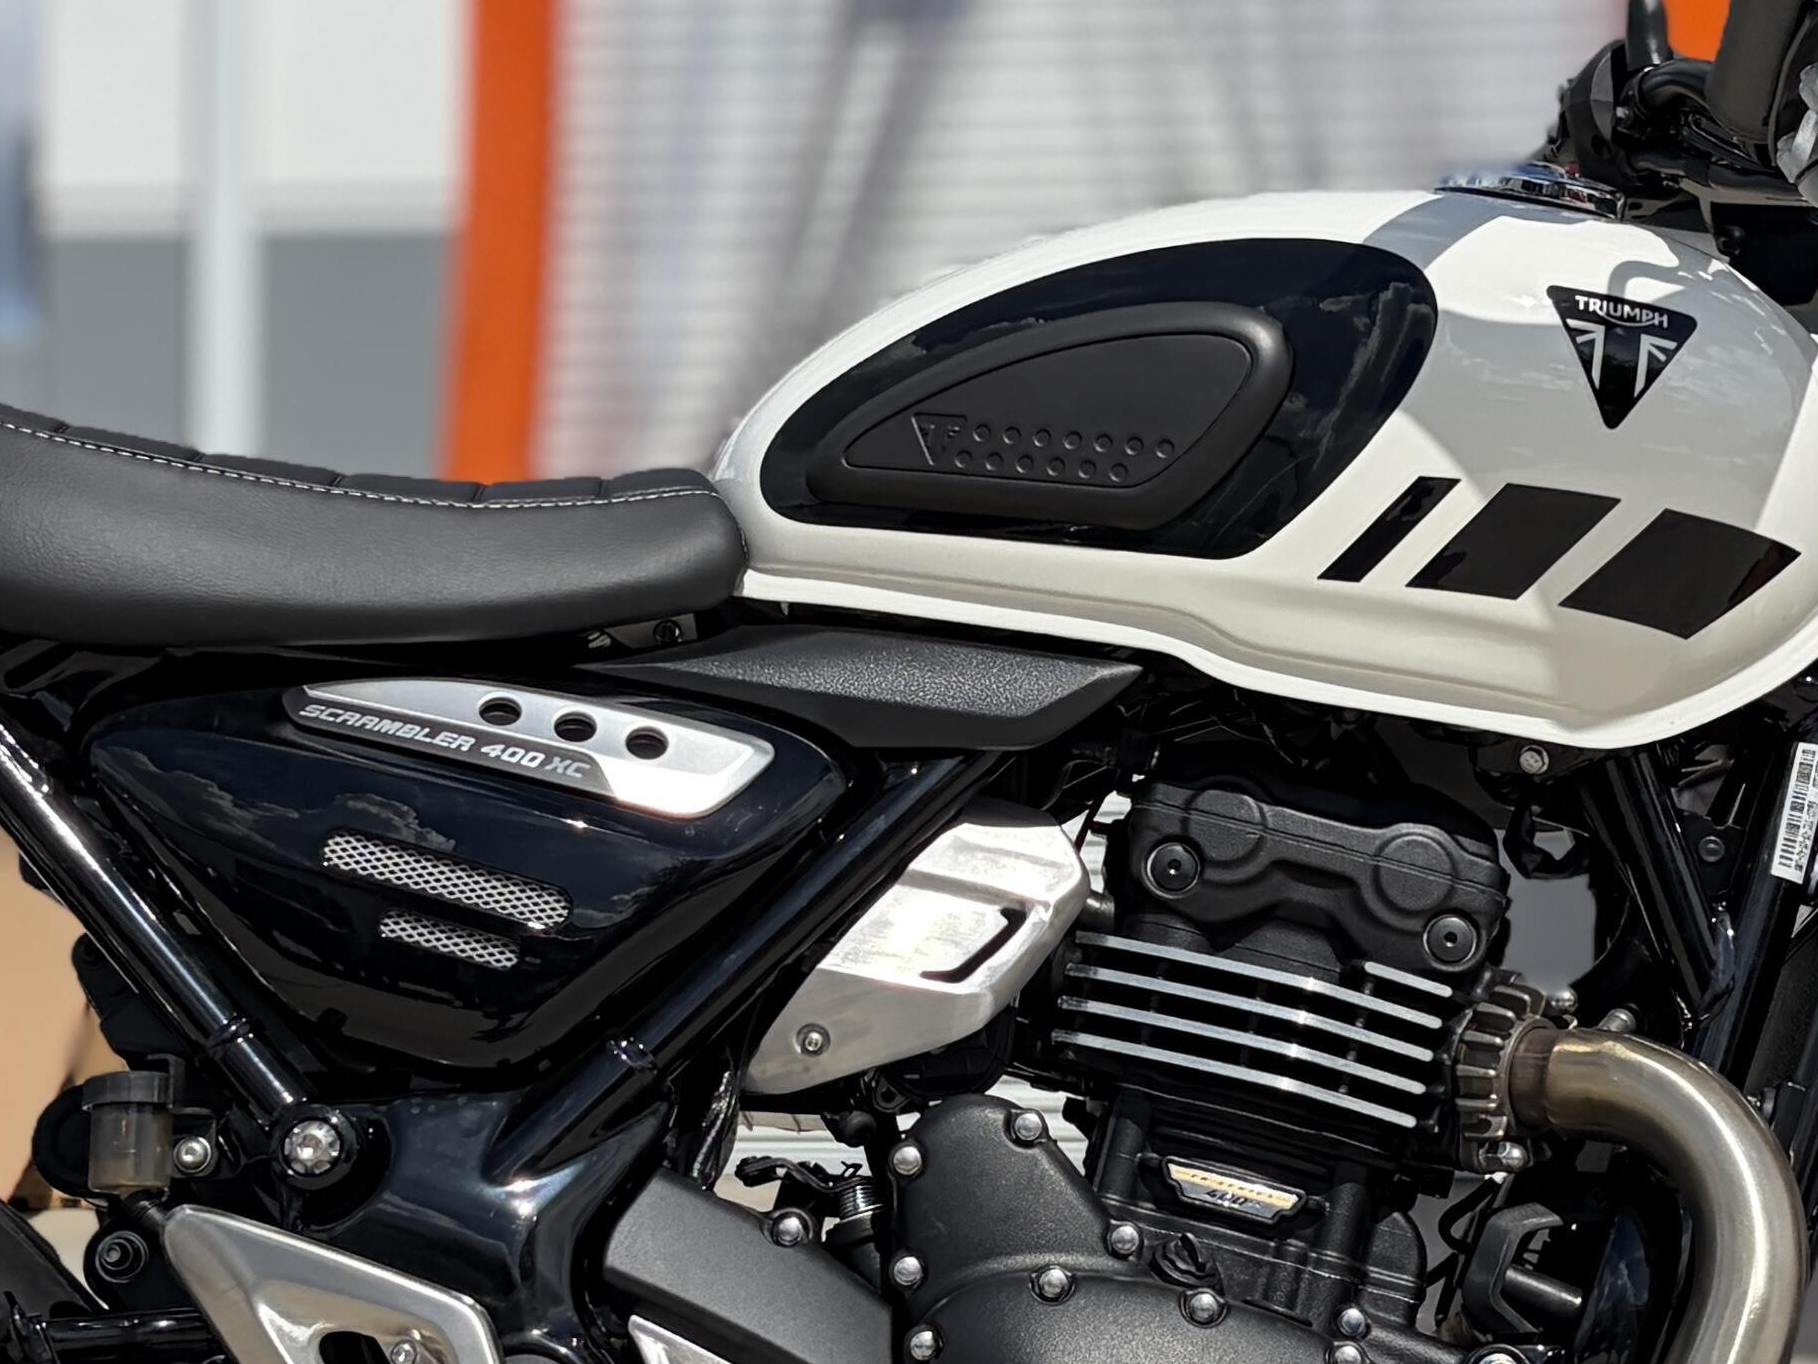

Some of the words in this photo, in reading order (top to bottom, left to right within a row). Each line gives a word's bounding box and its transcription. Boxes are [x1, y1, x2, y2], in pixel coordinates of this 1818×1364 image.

[1574, 294, 1669, 329] TRIUMPH
[298, 703, 477, 752] SCRAMBLER
[480, 743, 546, 769] 400
[545, 754, 592, 779] XC
